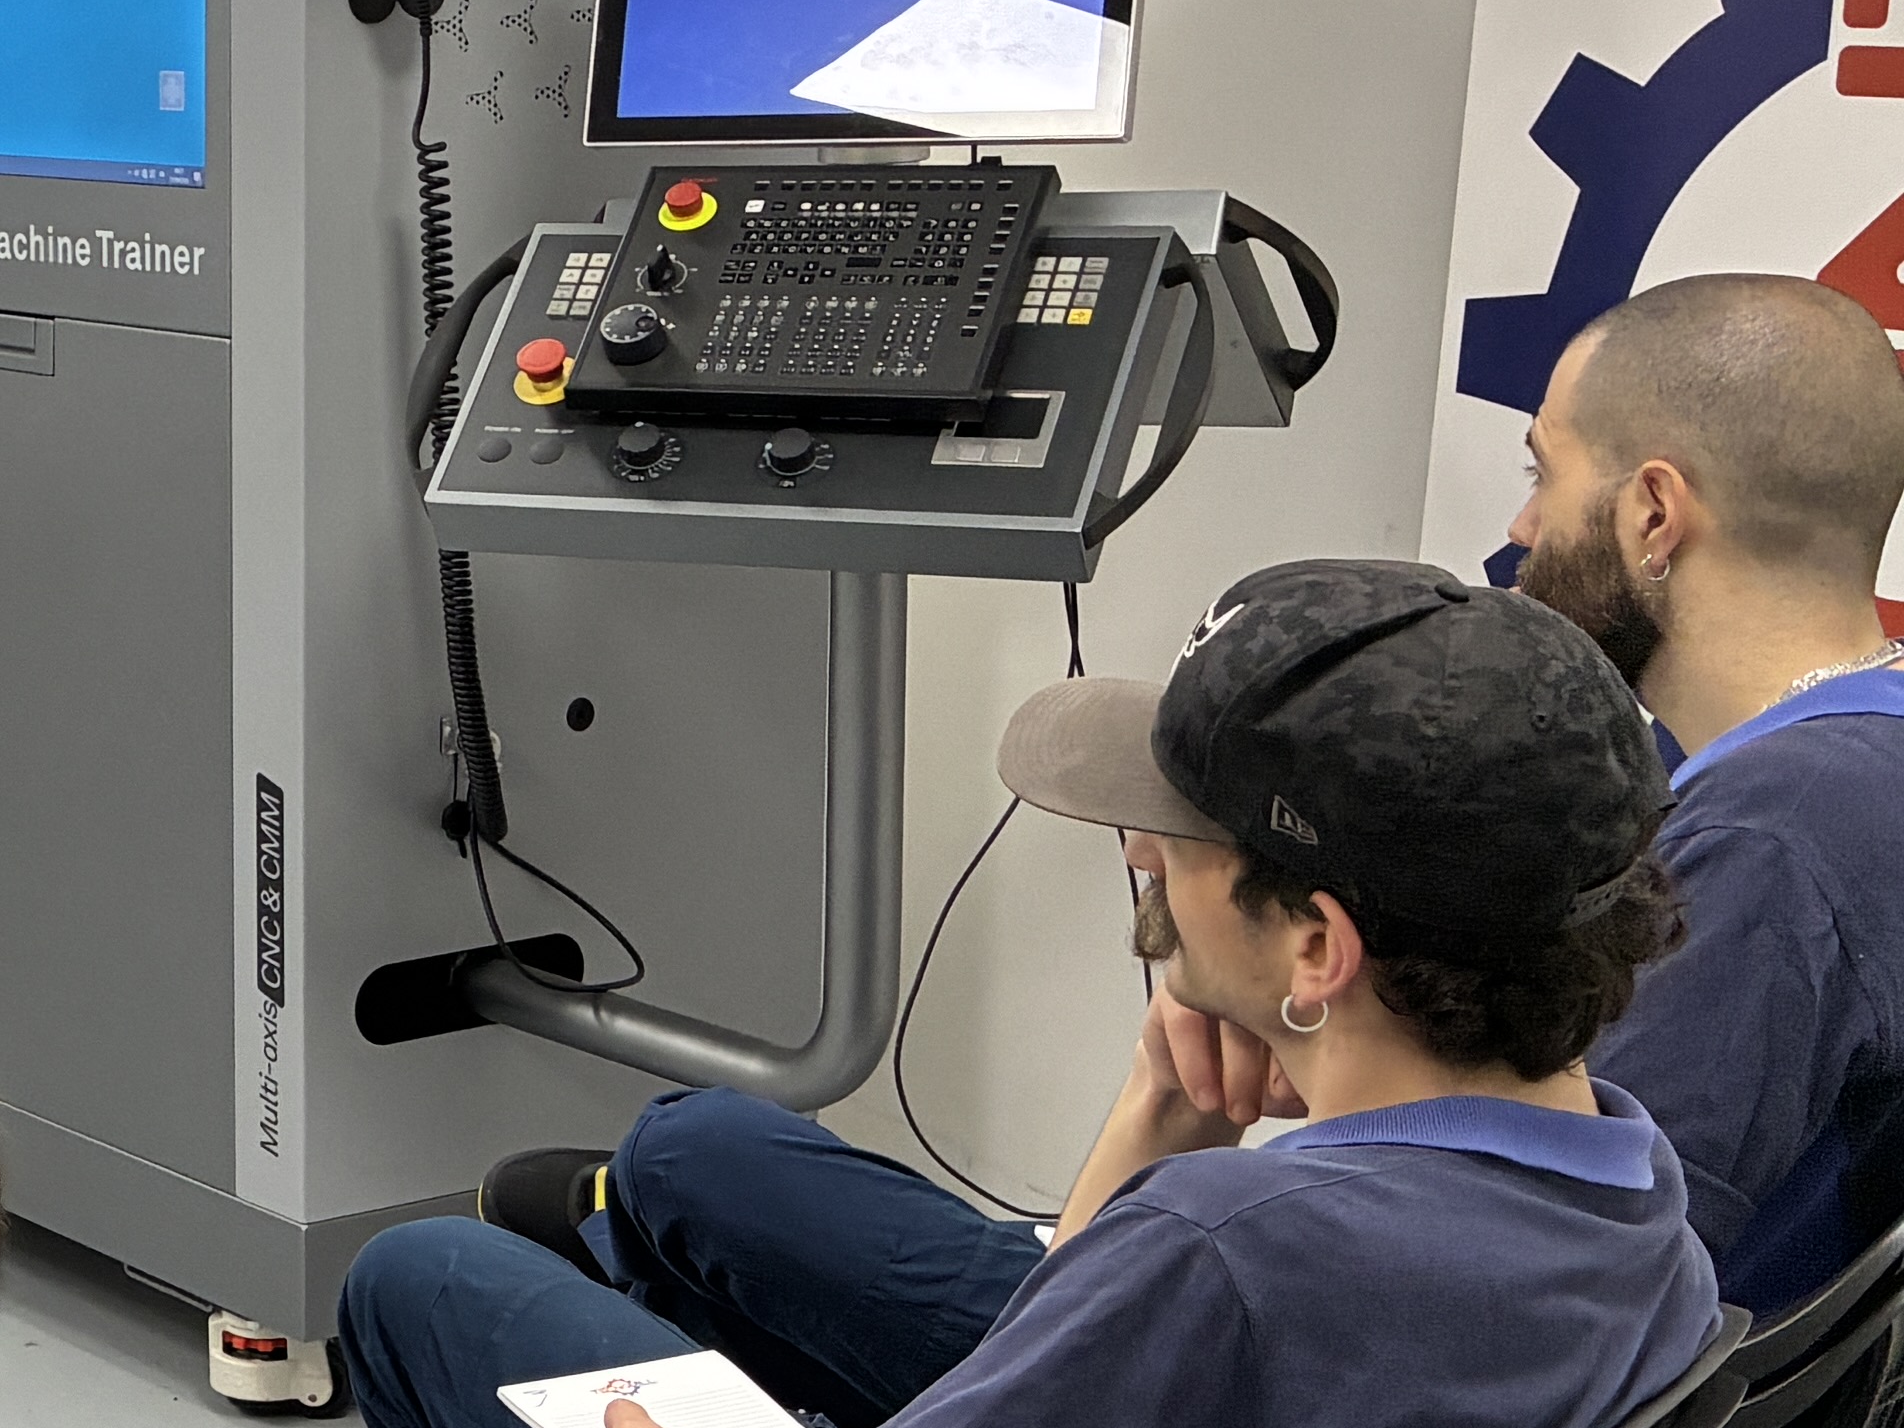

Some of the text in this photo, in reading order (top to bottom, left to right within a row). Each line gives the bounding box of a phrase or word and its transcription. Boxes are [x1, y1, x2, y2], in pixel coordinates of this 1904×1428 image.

[95, 228, 205, 276] Trainer
[258, 791, 282, 1158] Multi-axis CNC & CMM
